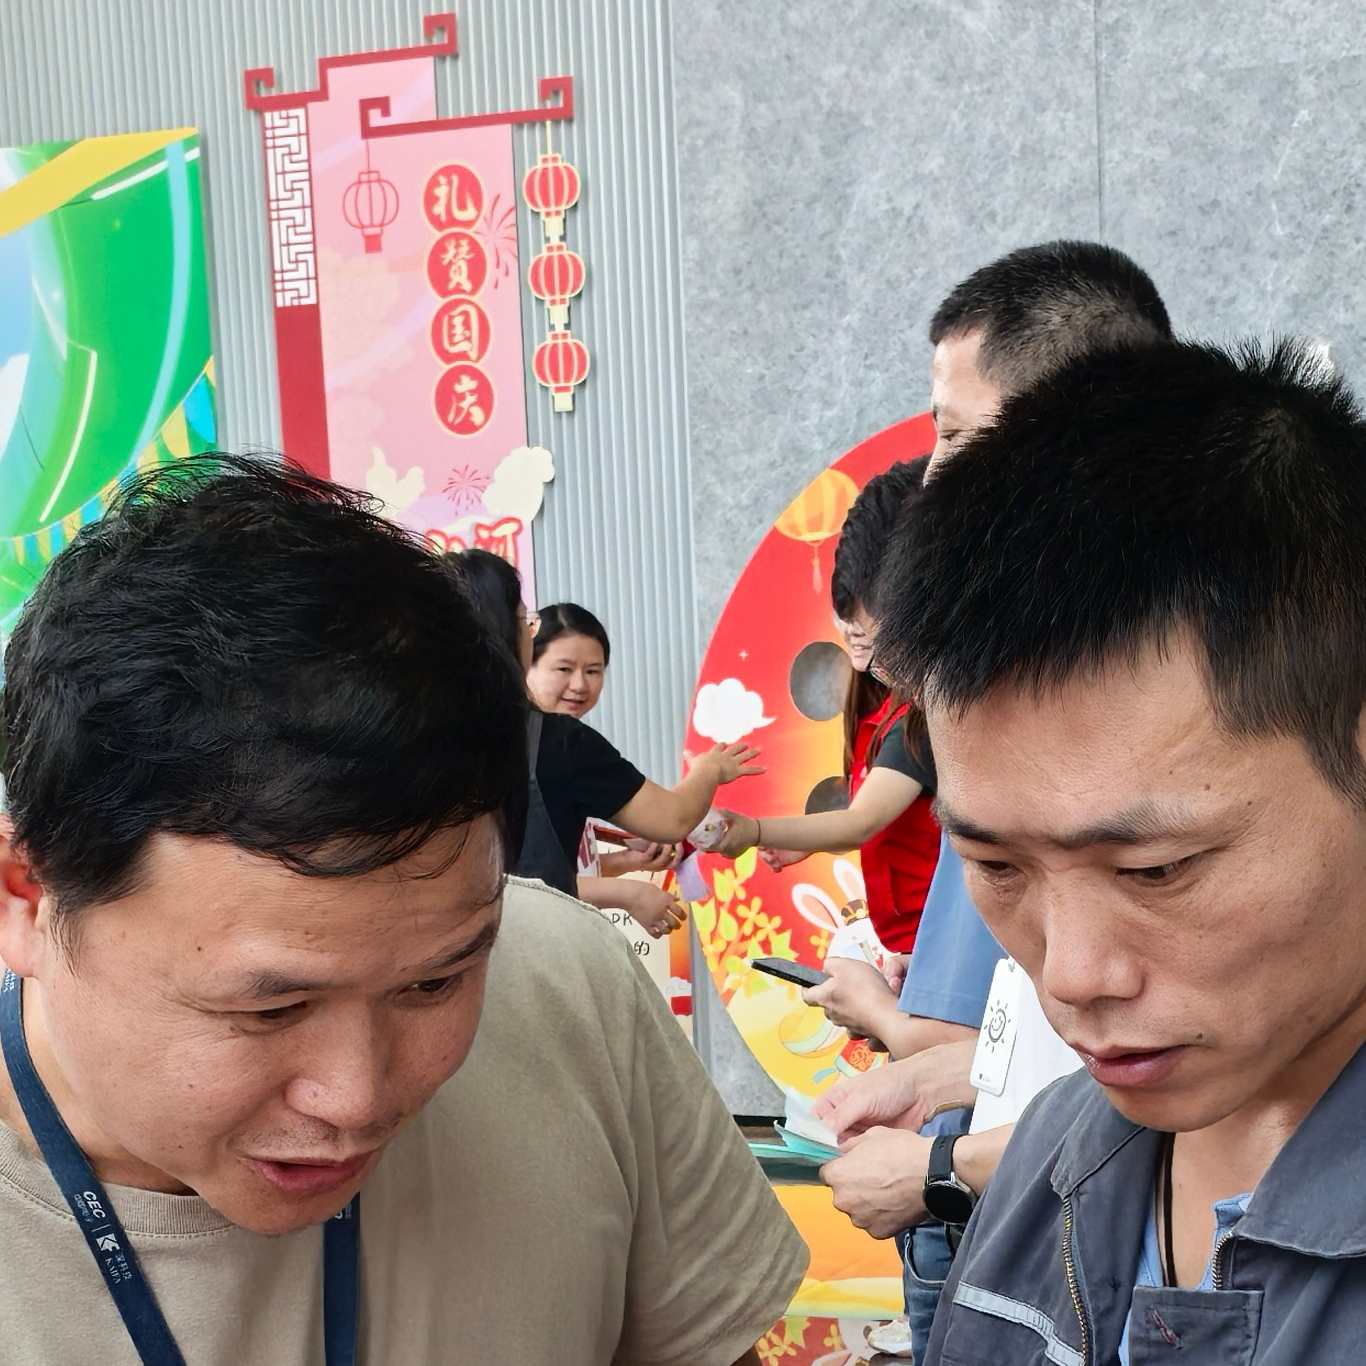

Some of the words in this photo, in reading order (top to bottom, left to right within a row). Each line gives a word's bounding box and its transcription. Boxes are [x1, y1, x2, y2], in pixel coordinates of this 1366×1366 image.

[432, 174, 487, 428] 礼赞国庆
[82, 1190, 107, 1219] CEC
